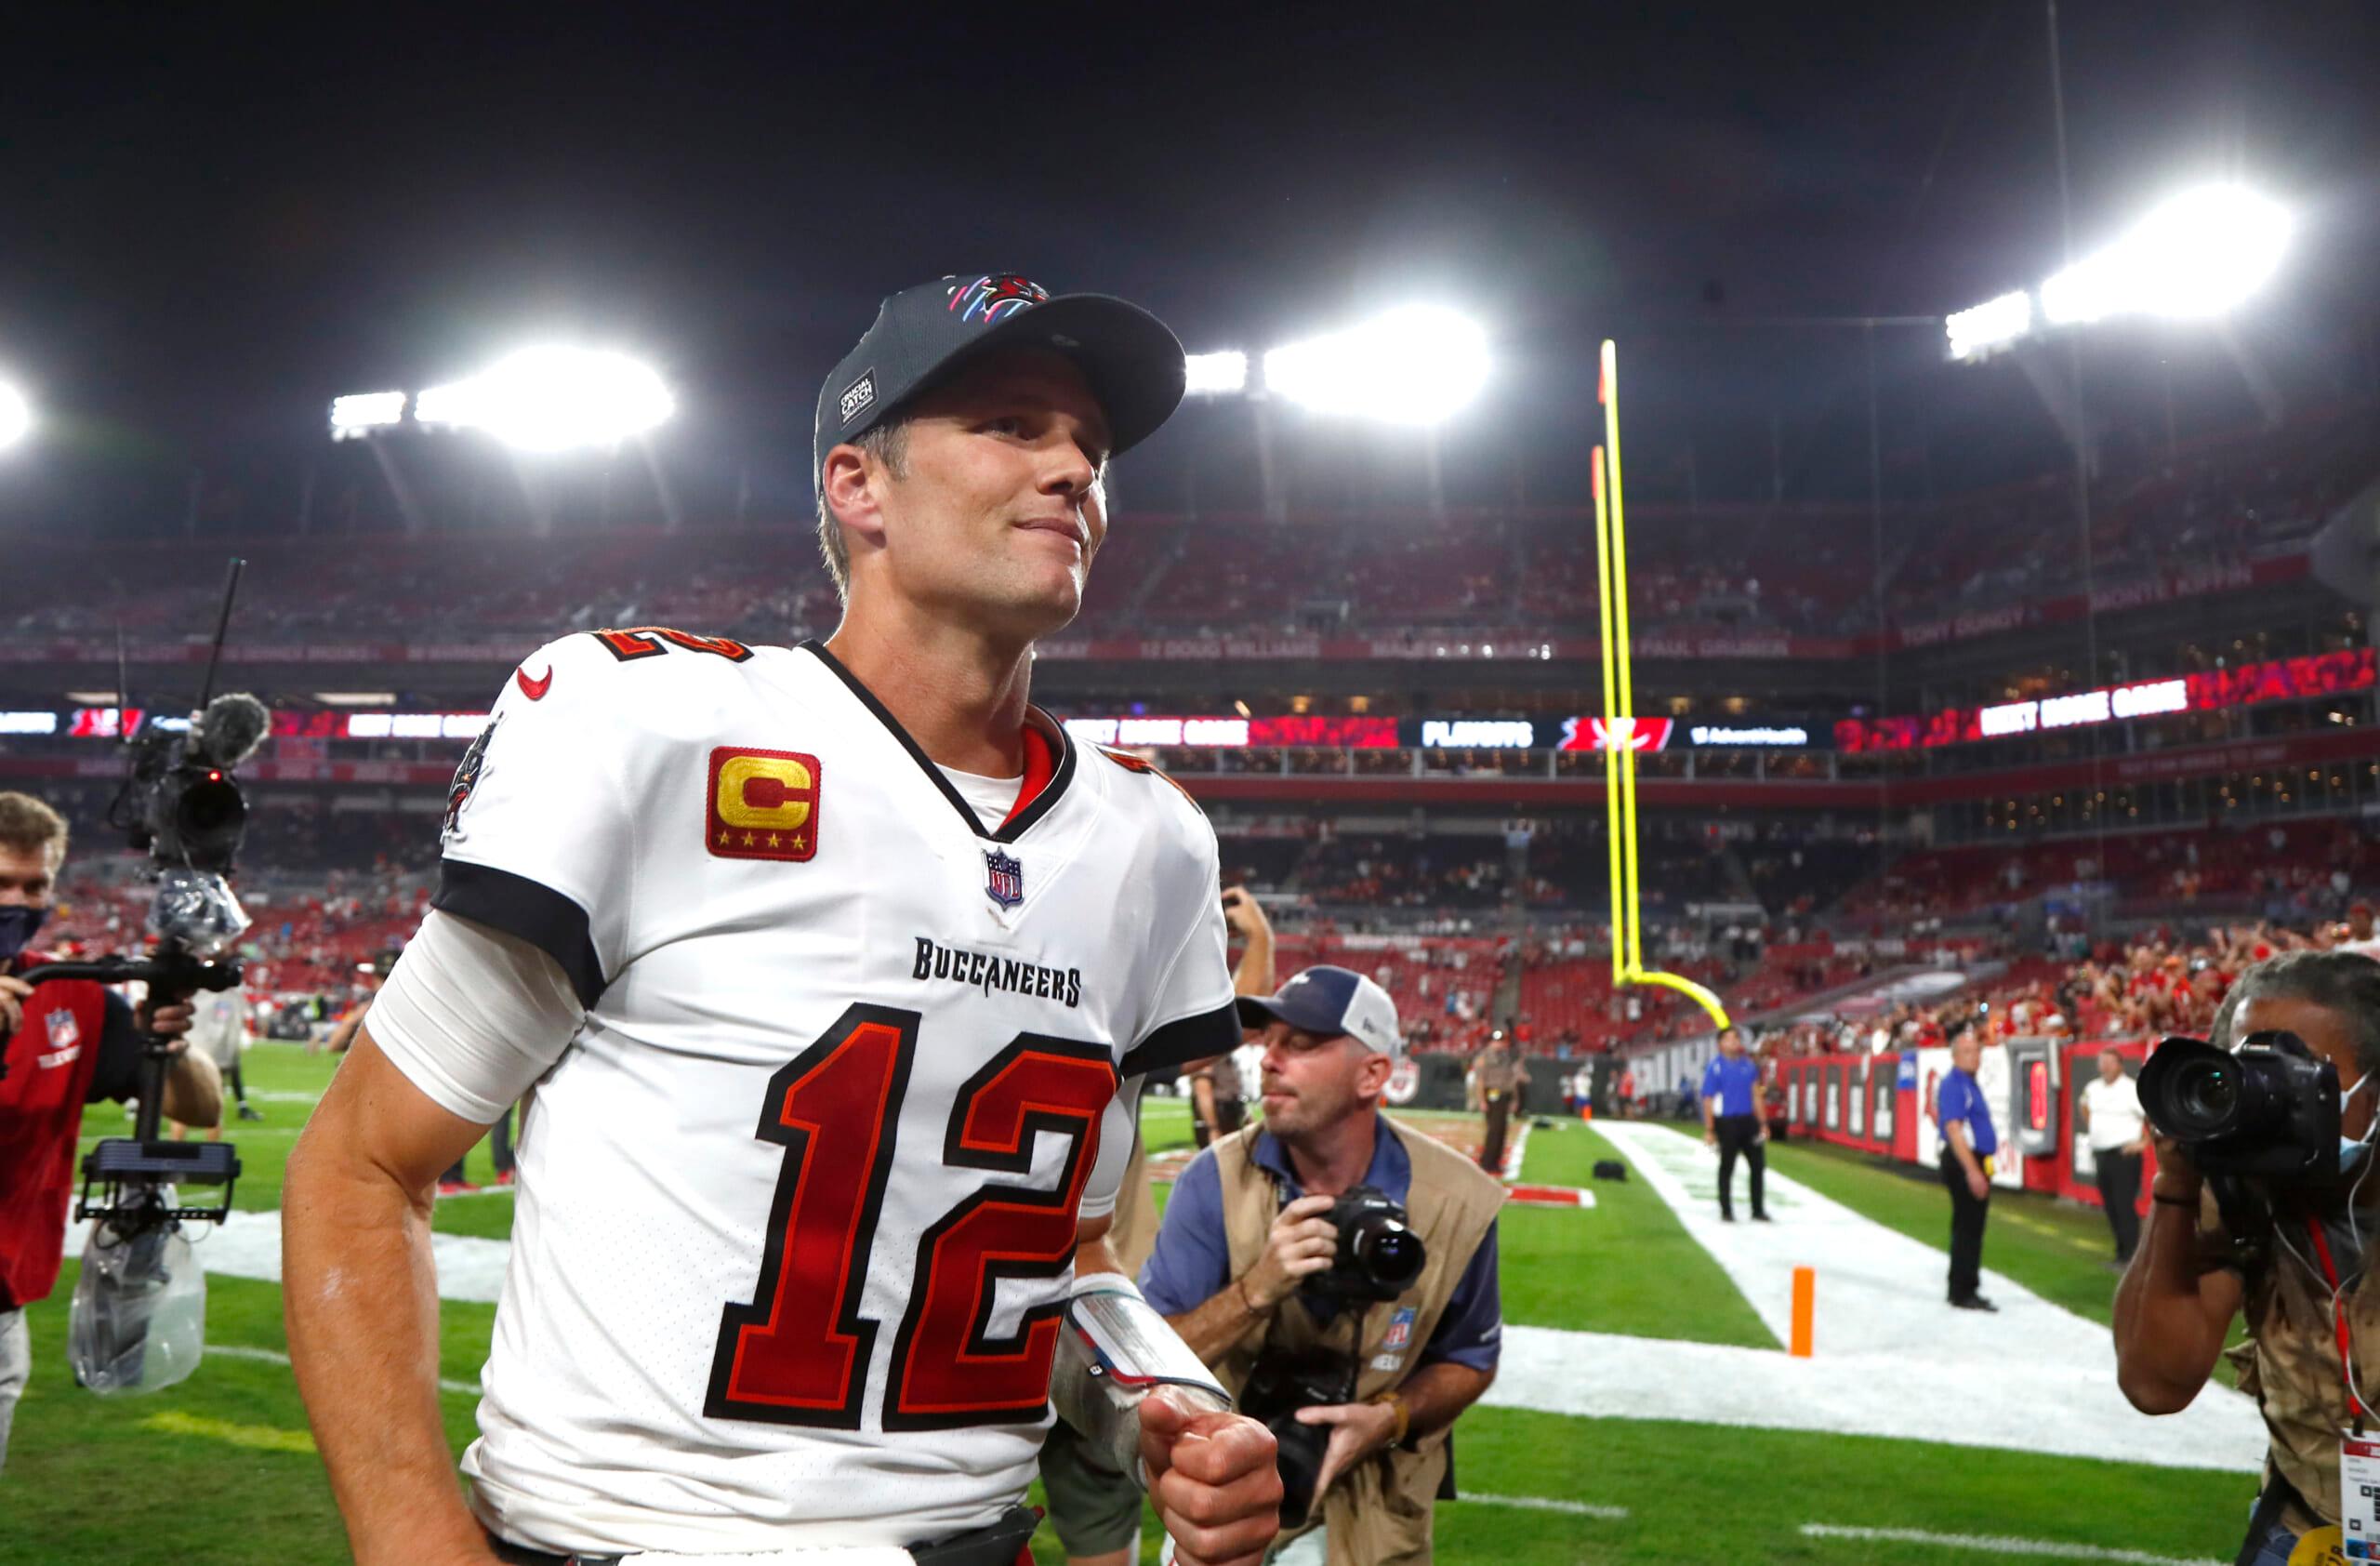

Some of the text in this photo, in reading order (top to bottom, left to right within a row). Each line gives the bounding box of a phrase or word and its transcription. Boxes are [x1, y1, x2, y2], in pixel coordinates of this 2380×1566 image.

[840, 378, 871, 405] CRUCIAL
[841, 384, 873, 416] CATCH
[1422, 721, 1534, 748] PLAYOFFS
[718, 755, 812, 830] C
[703, 1002, 1122, 1433] 12
